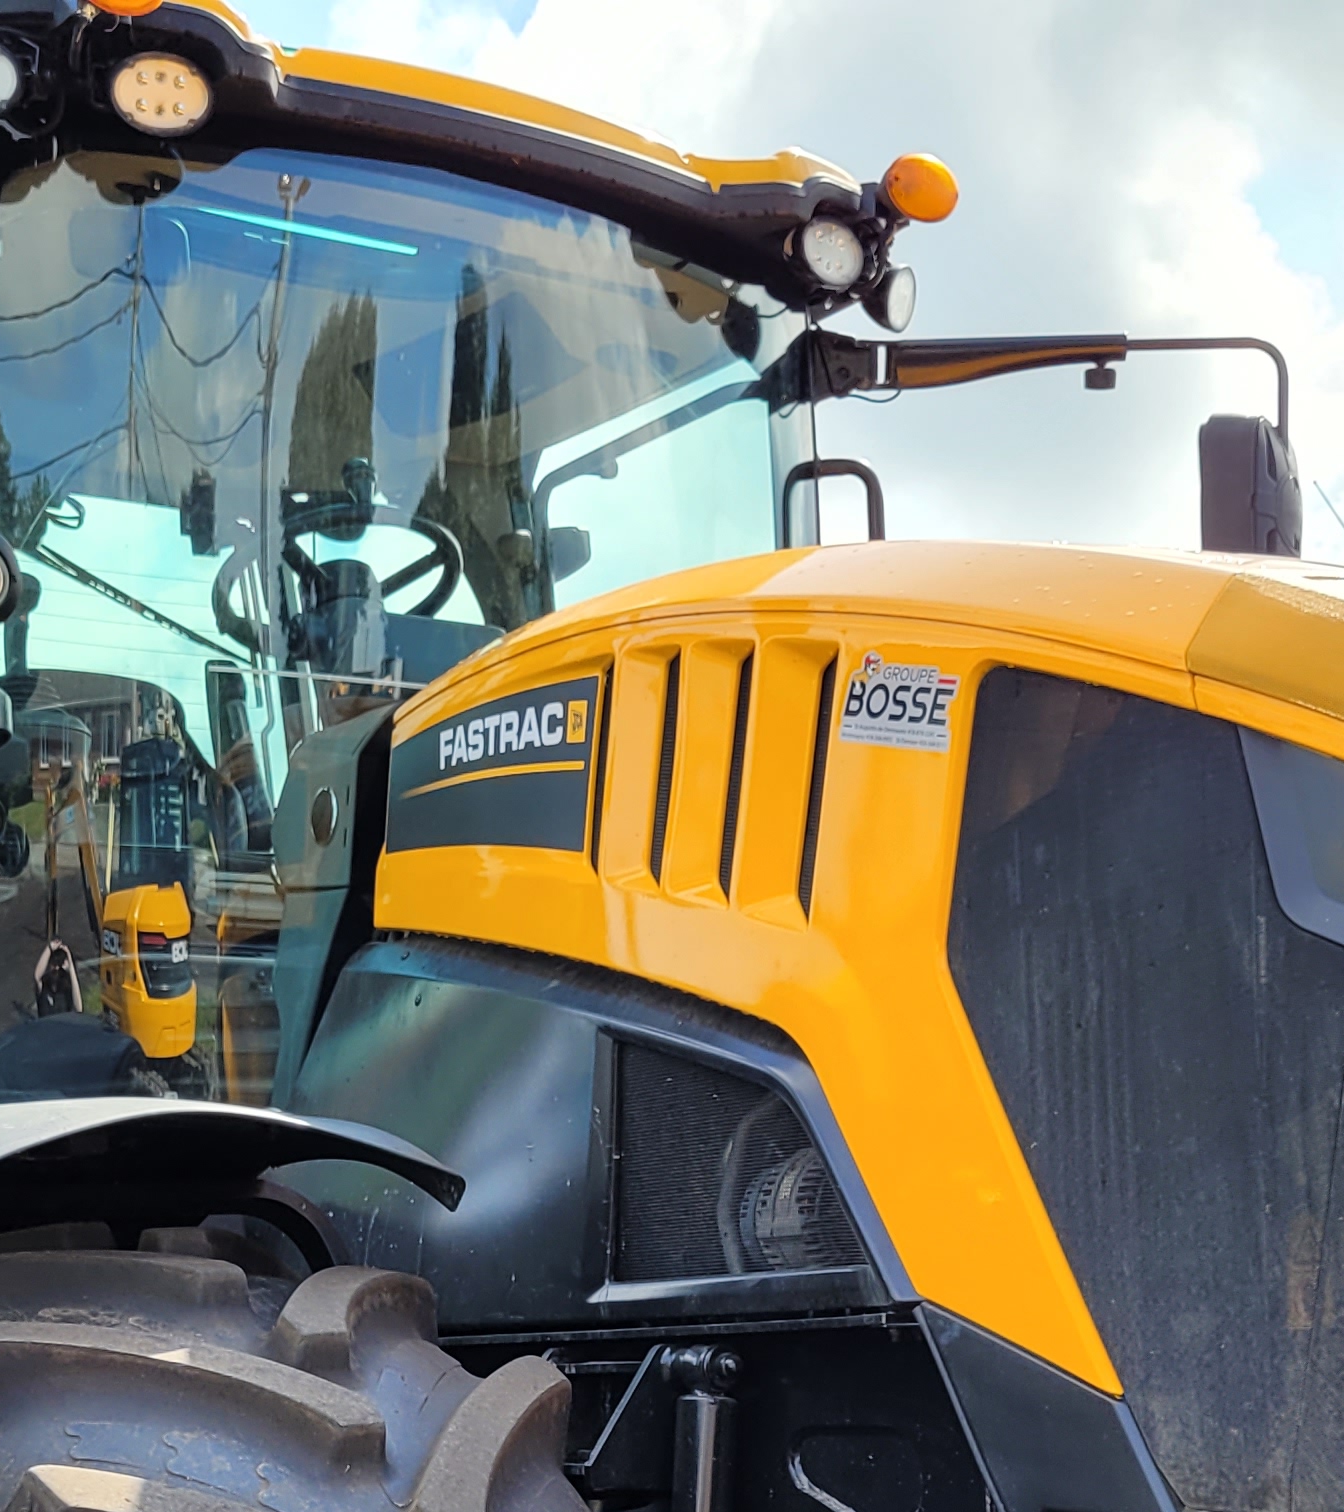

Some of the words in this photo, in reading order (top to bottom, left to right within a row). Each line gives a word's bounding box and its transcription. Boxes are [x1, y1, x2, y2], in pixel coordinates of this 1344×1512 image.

[883, 666, 937, 684] GROUPE
[844, 680, 955, 727] BOSSE
[439, 702, 564, 771] FASTRAC
